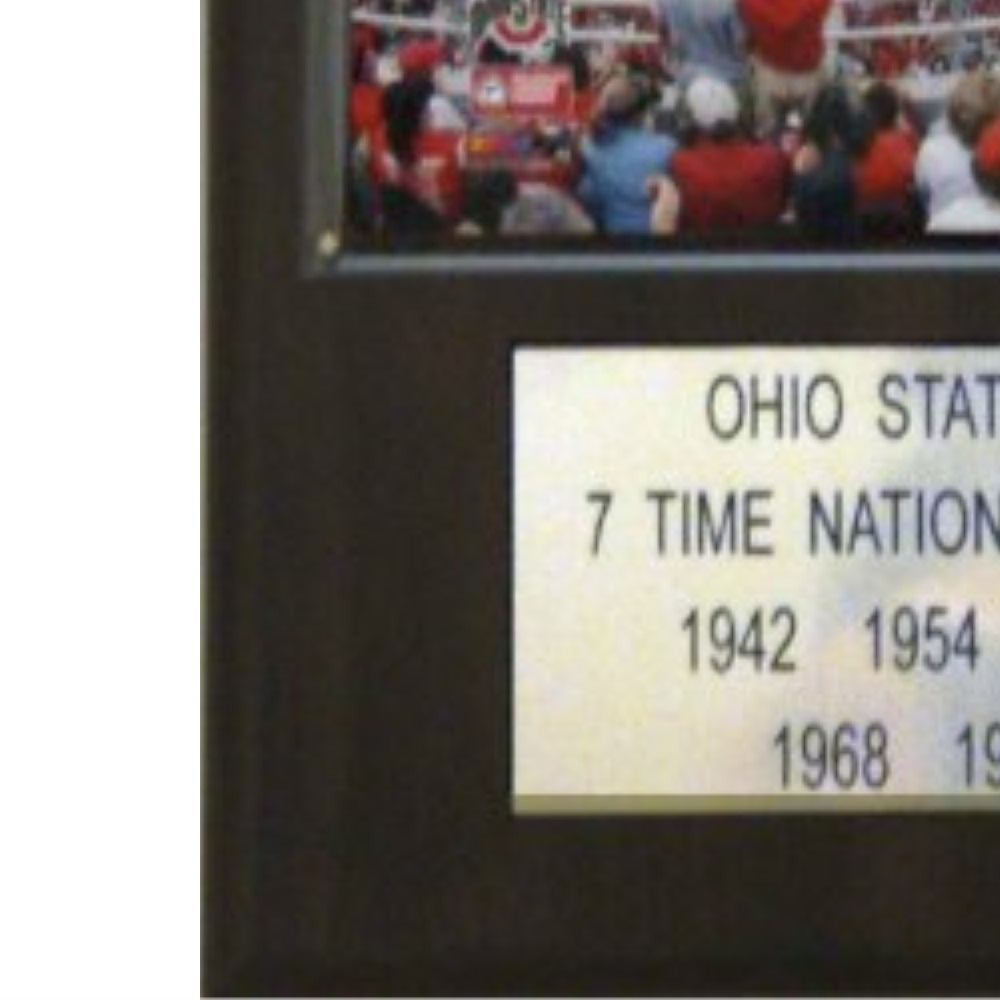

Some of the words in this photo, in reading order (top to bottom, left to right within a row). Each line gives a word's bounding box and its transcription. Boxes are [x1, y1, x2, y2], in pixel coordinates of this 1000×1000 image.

[706, 373, 844, 440] OHIO
[587, 491, 612, 555] 7
[647, 490, 772, 555] TIME
[681, 606, 797, 673] 1942
[864, 606, 981, 673] 1954
[772, 721, 889, 789] 1968
